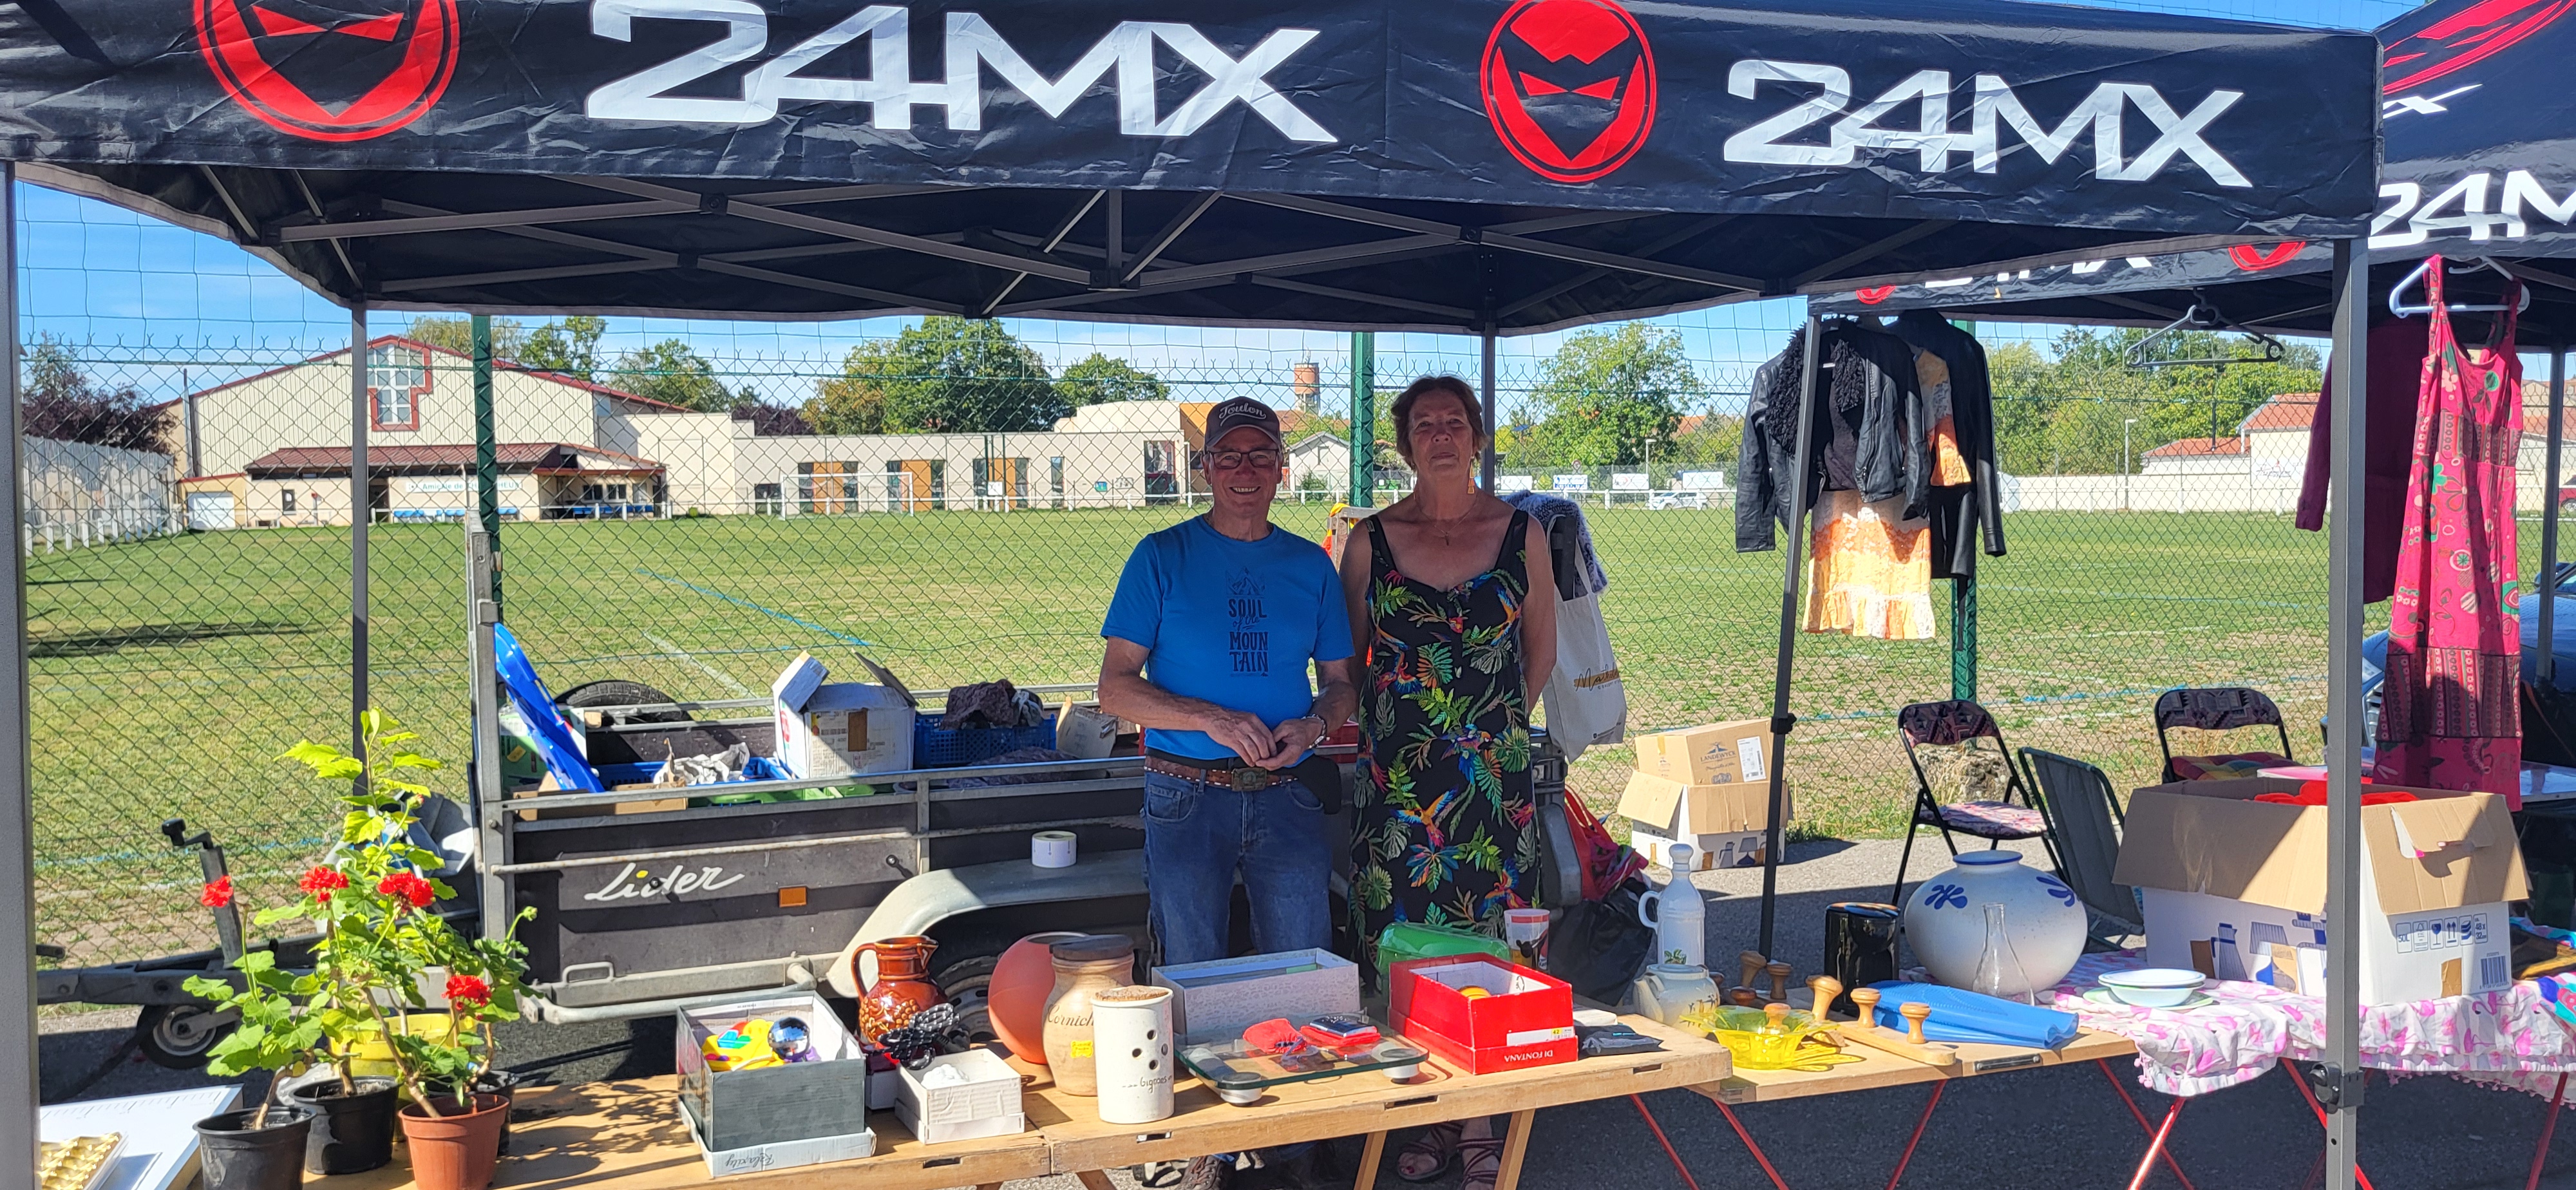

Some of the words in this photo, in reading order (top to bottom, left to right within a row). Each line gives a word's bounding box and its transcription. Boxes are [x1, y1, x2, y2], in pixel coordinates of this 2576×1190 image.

[585, 0, 1339, 143] 24MX
[1723, 59, 2253, 188] 24MX
[1219, 402, 1267, 420] Toulon
[1228, 598, 1267, 618] SOUL
[1229, 631, 1269, 651] MOUN
[1229, 651, 1269, 672] TAIN
[1700, 750, 1736, 762] LANDEWYCK
[584, 862, 745, 901] Lider
[2398, 934, 2410, 943] 50L
[1504, 1051, 1542, 1062] FONTANA
